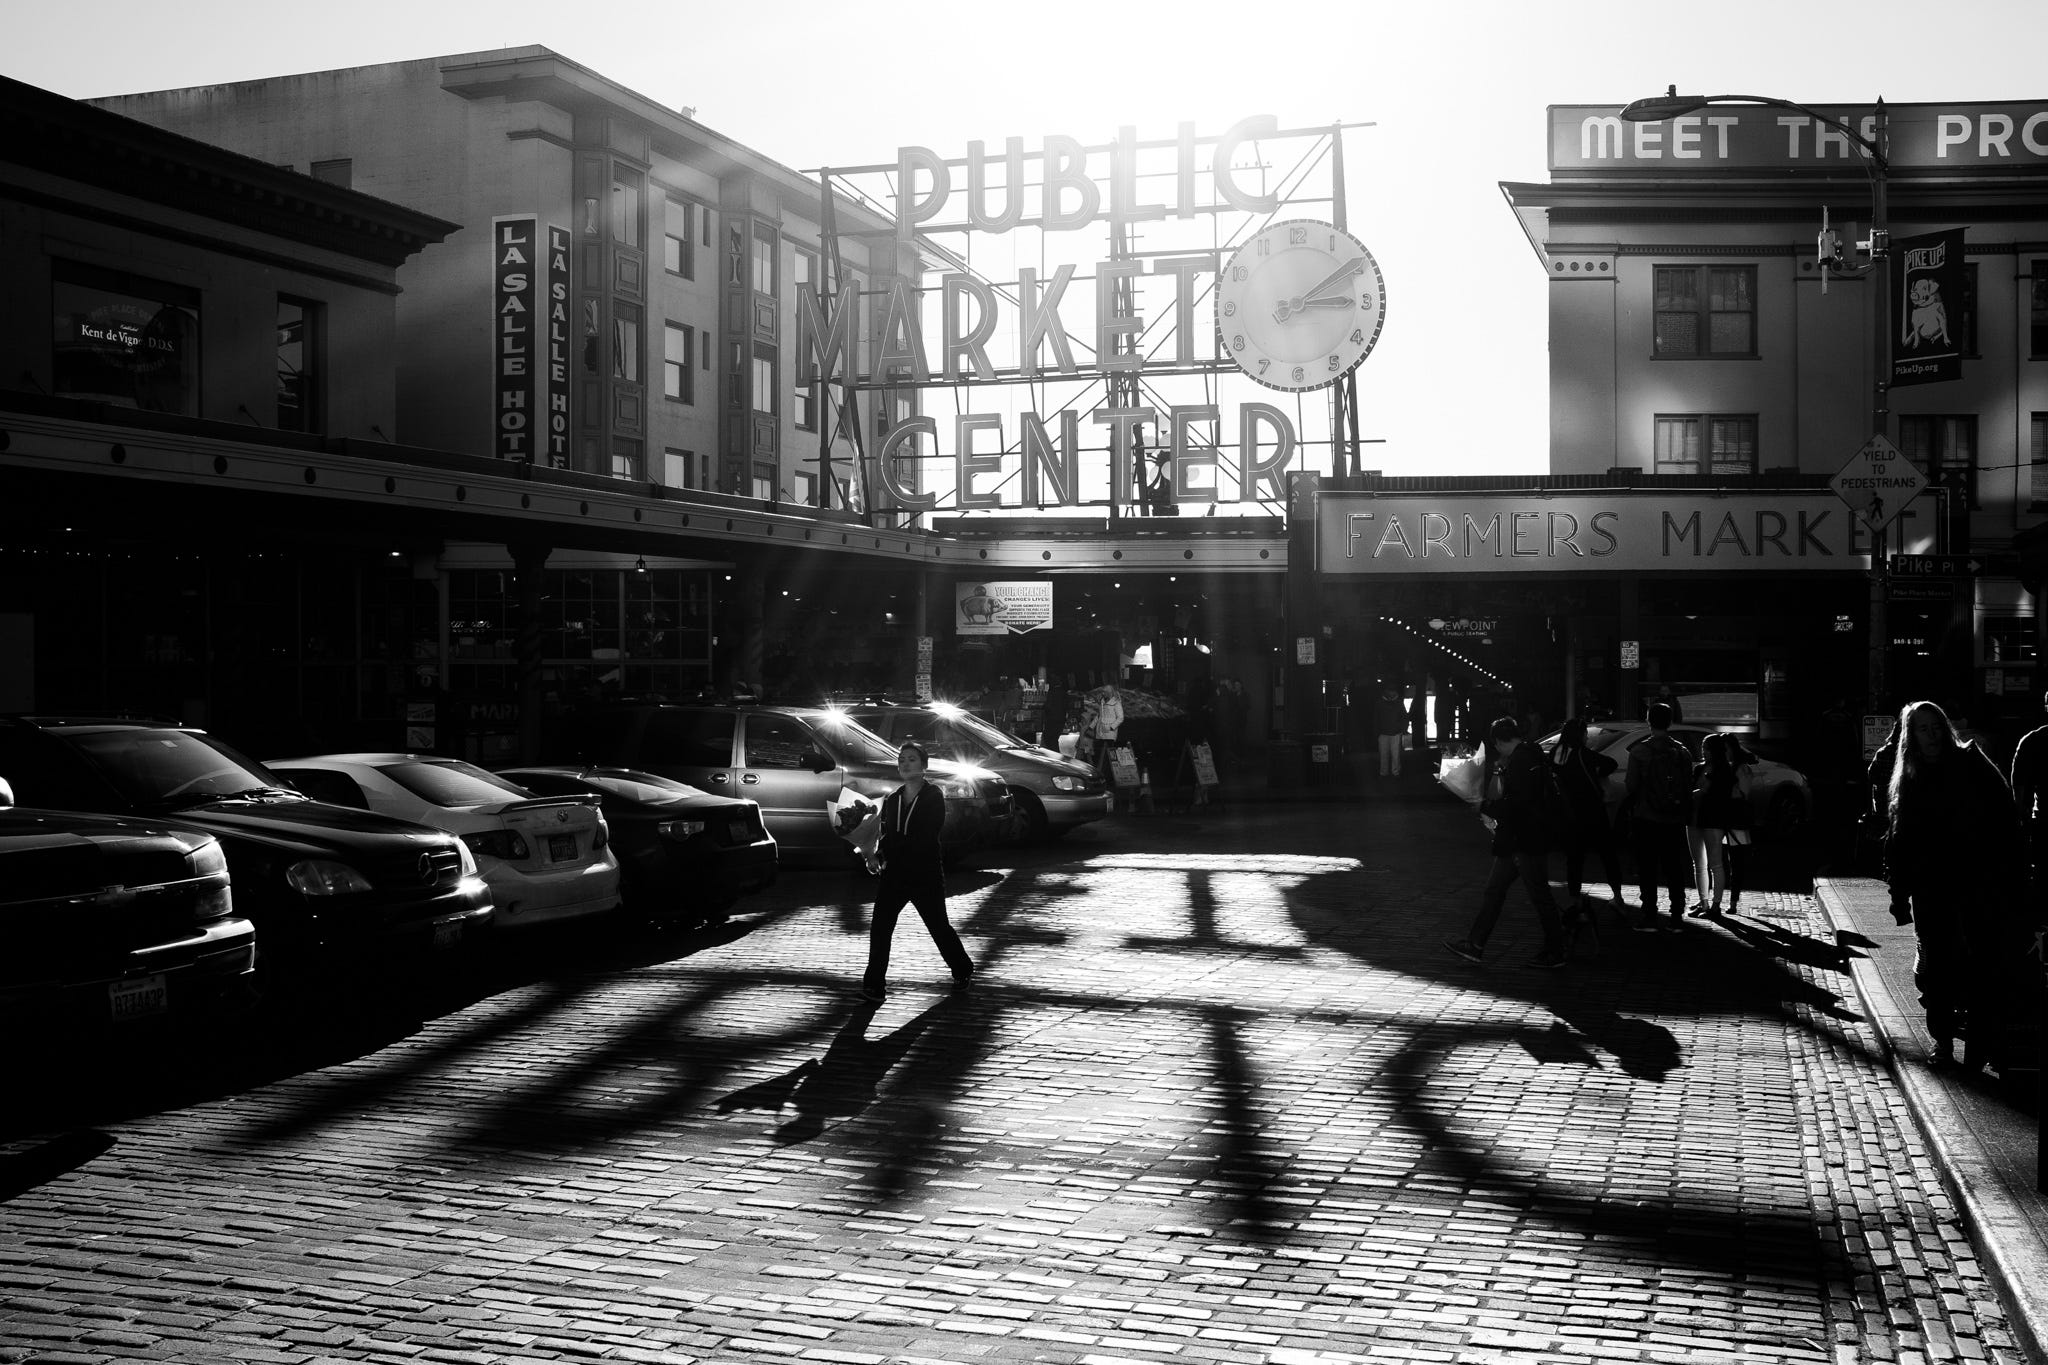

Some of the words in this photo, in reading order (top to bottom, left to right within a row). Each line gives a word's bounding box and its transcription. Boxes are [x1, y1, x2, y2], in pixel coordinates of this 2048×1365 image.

[1581, 116, 1739, 159] MEET
[898, 115, 1278, 242] PUBLIC
[1290, 228, 1307, 244] 12
[1330, 235, 1335, 251] 1
[501, 226, 527, 265] LA
[552, 231, 566, 272] LA
[1258, 239, 1270, 256] 11
[1906, 251, 1927, 271] PIKE
[1929, 244, 1945, 265] UP!
[1233, 266, 1248, 281] 10
[1224, 301, 1236, 316] 9
[1361, 293, 1372, 310] 3
[501, 273, 528, 376] SALLE
[799, 257, 1217, 387] MARKET
[81, 324, 104, 339] Kent
[106, 329, 117, 341] de
[552, 282, 566, 382] SALLE
[1350, 329, 1364, 345] 4
[1233, 335, 1245, 351] 8
[1258, 359, 1271, 375] 7
[1328, 355, 1340, 371] 5
[1291, 367, 1304, 382] 6
[880, 402, 1295, 510] CENTER
[1863, 450, 1896, 461] YIELD
[1872, 464, 1886, 475] TO
[1841, 477, 1916, 489] PEDESTRIANS
[1345, 511, 1619, 559] FARMERS
[1897, 556, 1933, 573] Pike
[1942, 562, 1955, 573] Pl
[995, 586, 1015, 597] YOUR
[1017, 586, 1050, 597] CHANGE
